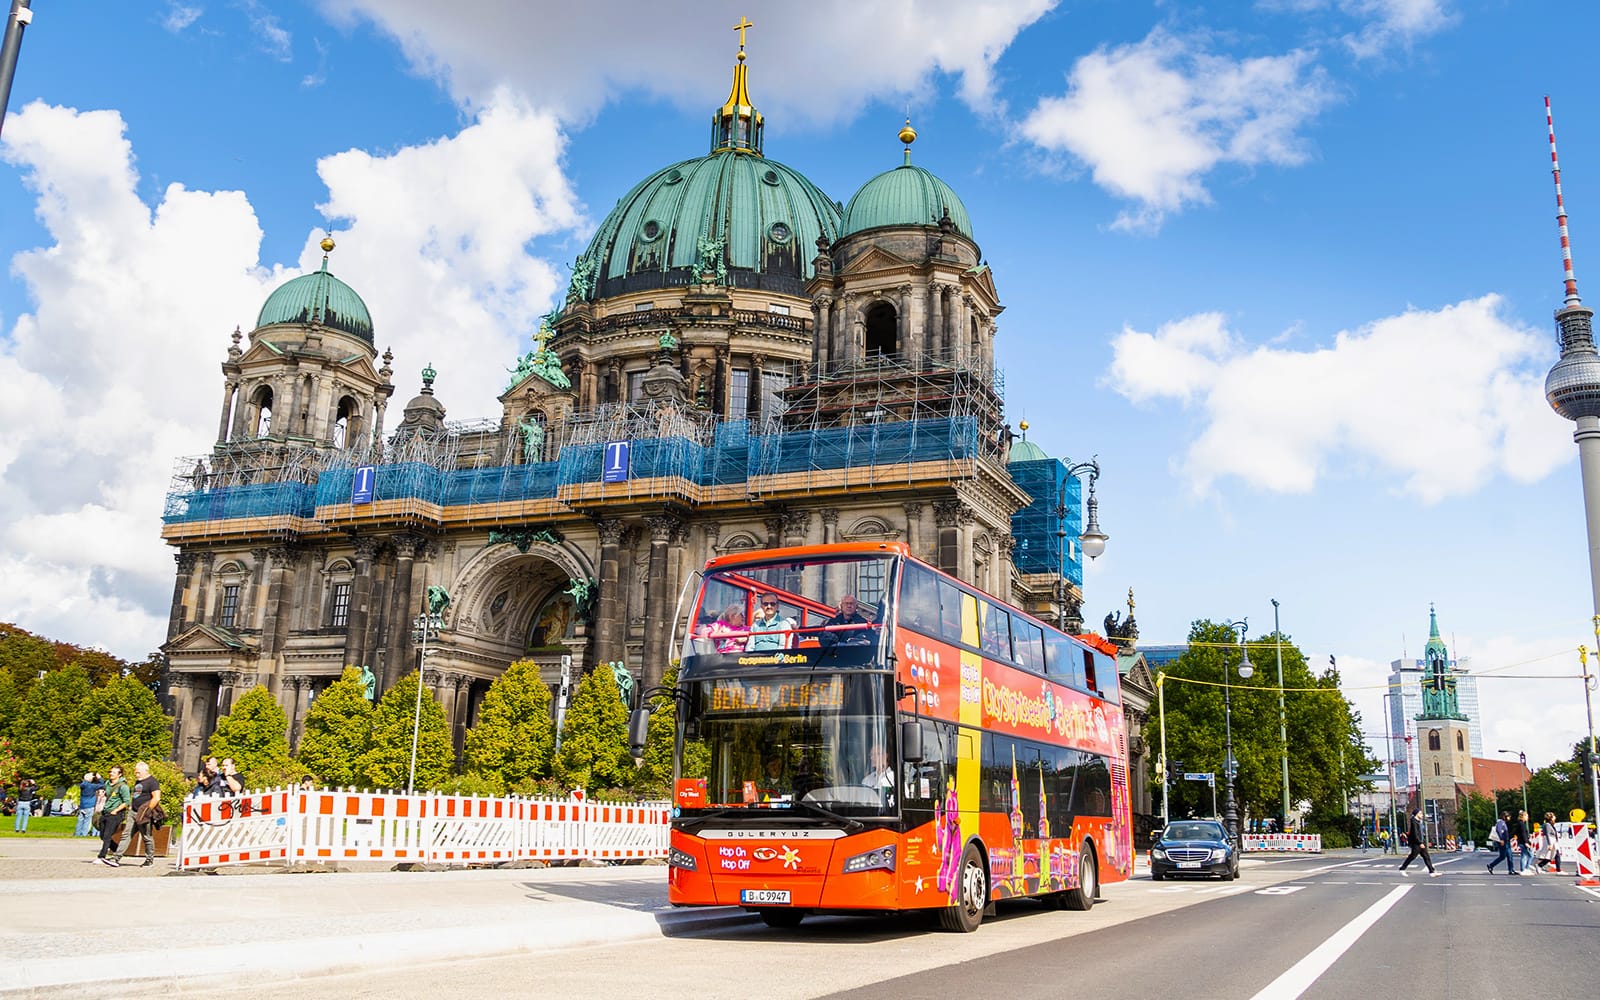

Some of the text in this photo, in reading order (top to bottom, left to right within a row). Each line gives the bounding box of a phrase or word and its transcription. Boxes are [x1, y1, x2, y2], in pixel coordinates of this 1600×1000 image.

[608, 442, 628, 469] T
[357, 467, 374, 492] T
[783, 654, 807, 663] Berlin
[713, 686, 771, 710] BERLIN
[983, 677, 1088, 740] CitySightseeing Berlin
[719, 846, 747, 857] Hop On
[721, 860, 751, 870] Hop Off
[766, 891, 787, 901] 9947
